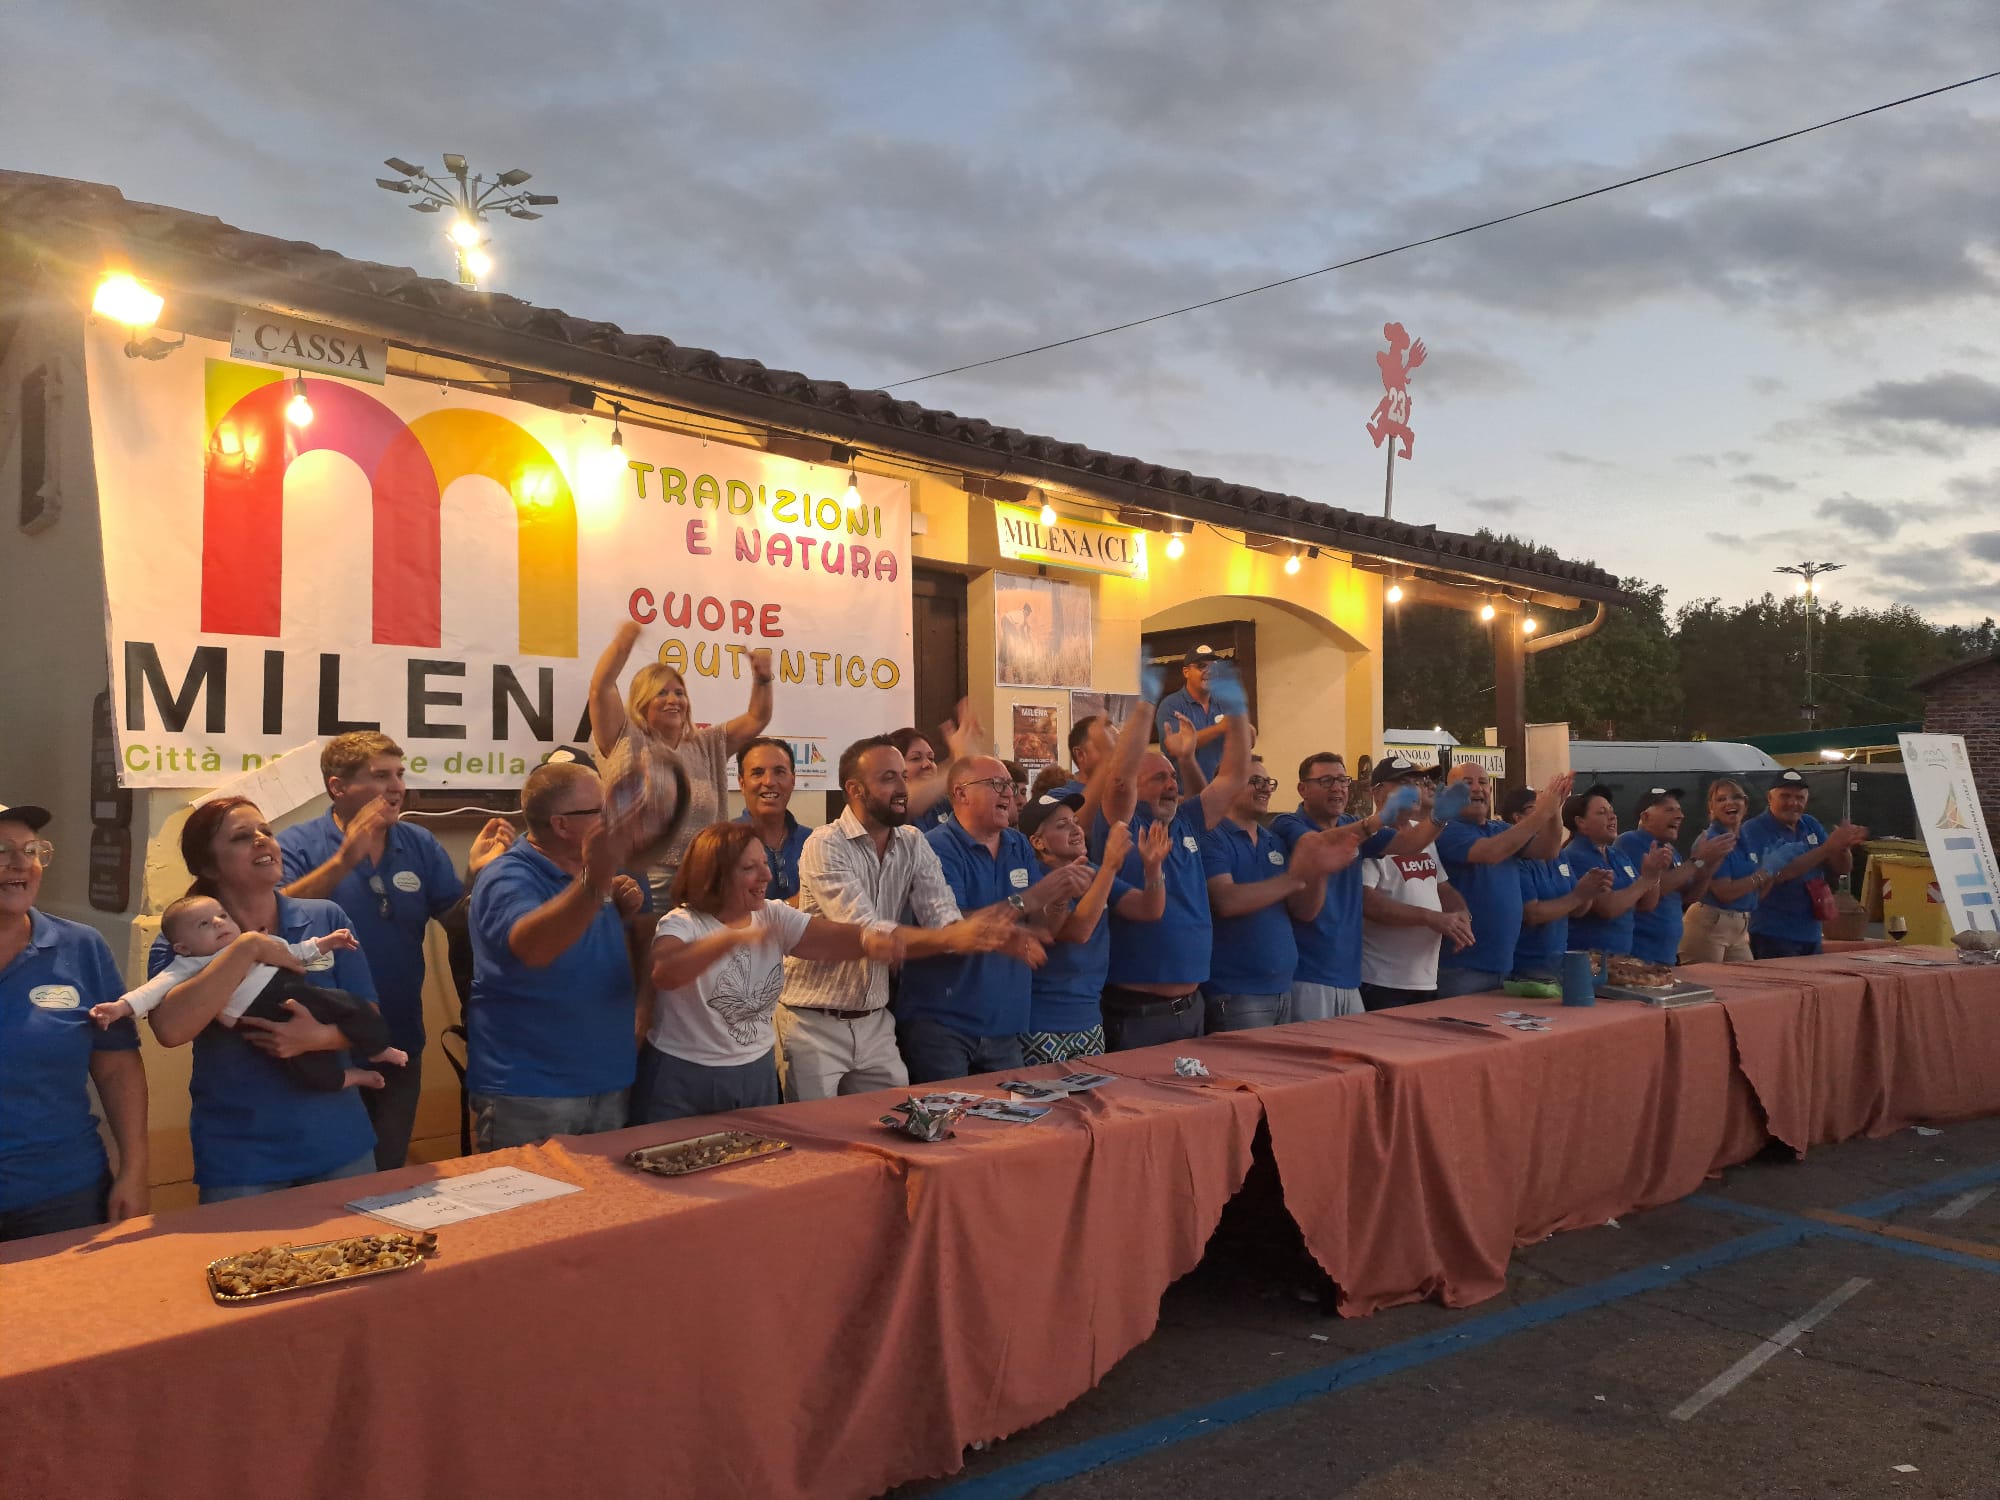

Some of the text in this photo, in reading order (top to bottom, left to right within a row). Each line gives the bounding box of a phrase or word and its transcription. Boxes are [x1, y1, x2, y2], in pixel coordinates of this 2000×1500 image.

[254, 324, 369, 369] CASSA
[1388, 387, 1405, 424] 23
[628, 461, 881, 538] TRADIZIONI
[686, 519, 898, 582] E NATURA
[1004, 517, 1093, 558] MILENA
[628, 587, 784, 637] CUORE
[125, 641, 592, 743] MILEN
[1021, 708, 1048, 718] MILENA
[125, 744, 221, 772] Città
[444, 752, 525, 774] della
